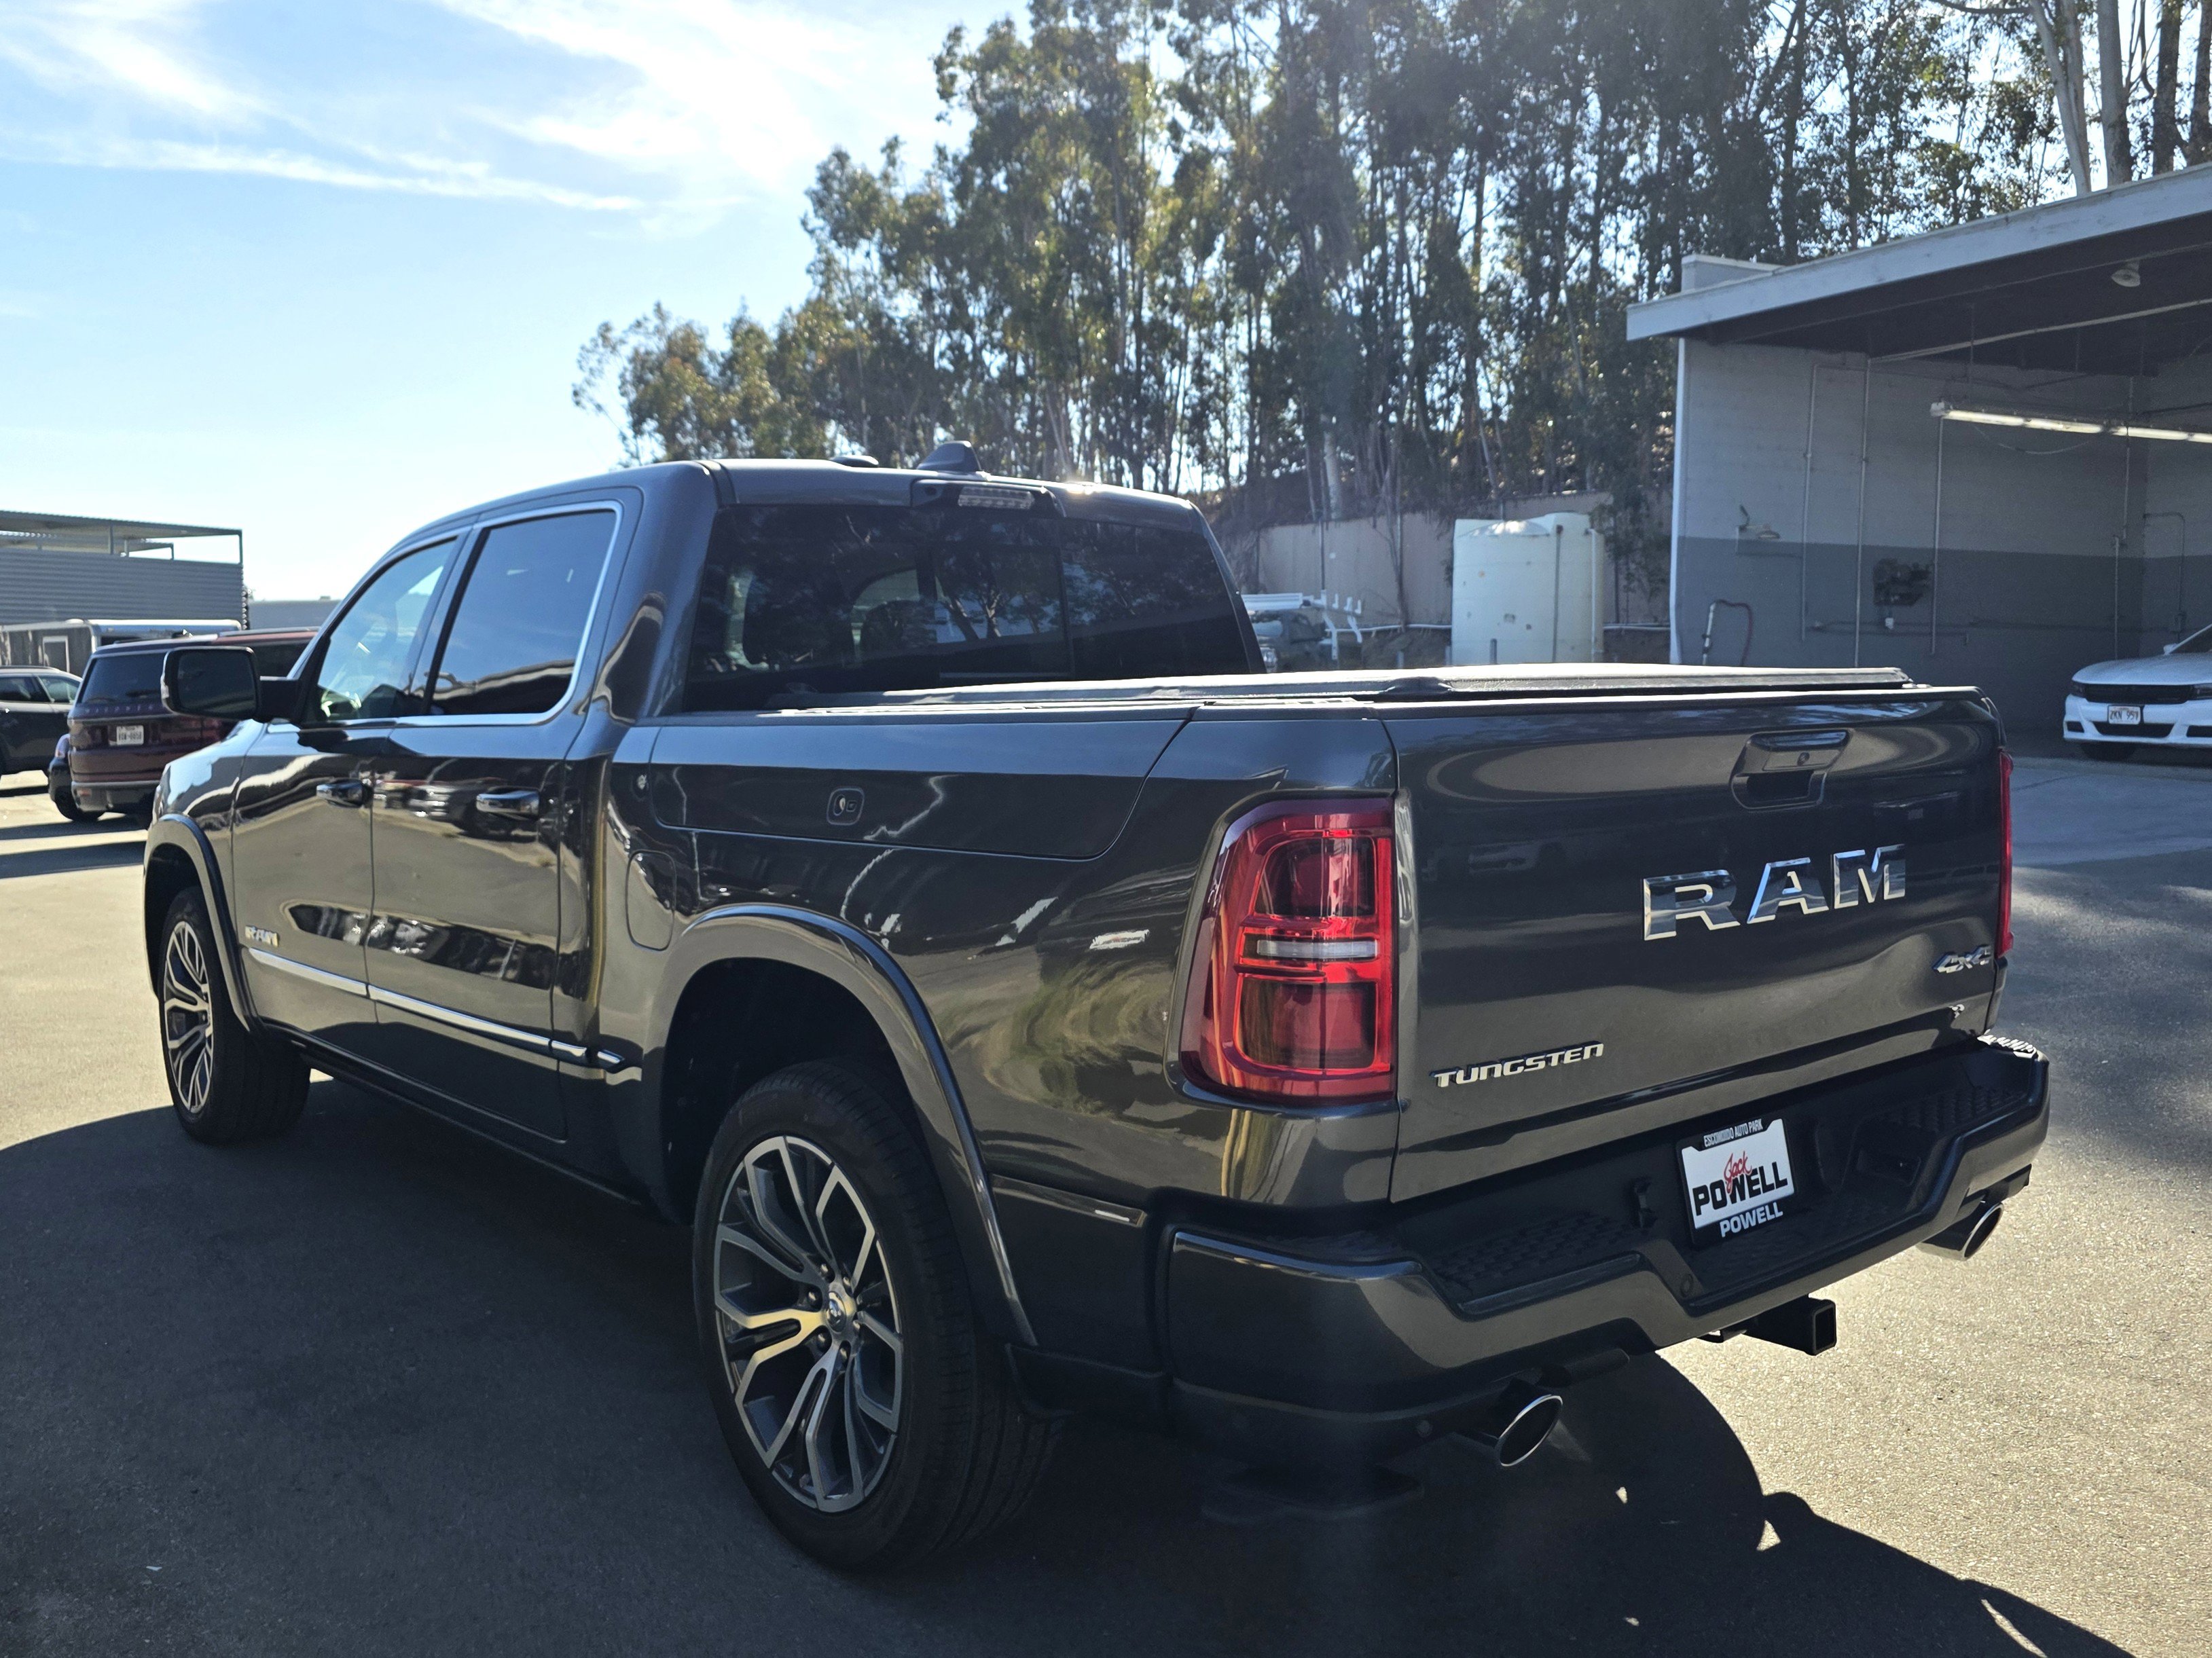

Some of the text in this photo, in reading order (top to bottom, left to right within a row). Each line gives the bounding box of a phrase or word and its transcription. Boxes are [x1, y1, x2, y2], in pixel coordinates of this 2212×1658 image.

[1644, 843, 1906, 941] RAM
[245, 925, 278, 947] RAM
[1430, 1042, 1604, 1088] TUNGSTEN
[1703, 1118, 1764, 1147] ESCODO AUTO PARK
[1692, 1161, 1788, 1216] POWELL
[1724, 1150, 1752, 1195] Jack
[1719, 1201, 1783, 1238] POWELL
